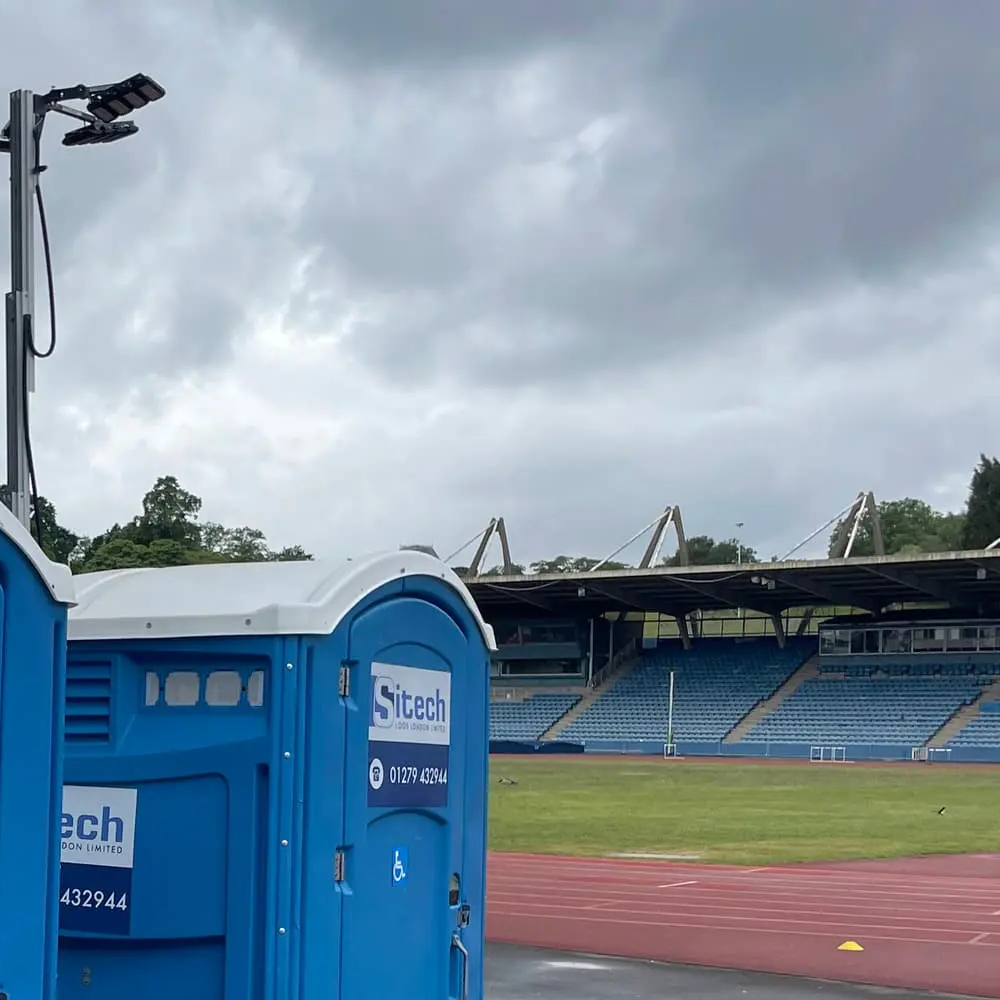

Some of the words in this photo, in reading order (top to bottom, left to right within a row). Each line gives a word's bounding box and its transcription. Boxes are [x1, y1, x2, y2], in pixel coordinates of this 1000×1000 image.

[373, 676, 445, 728] Sitech
[390, 766, 417, 784] 01279
[420, 767, 447, 785] 432944
[87, 844, 123, 854] LIMITED
[60, 888, 127, 911] 432944
